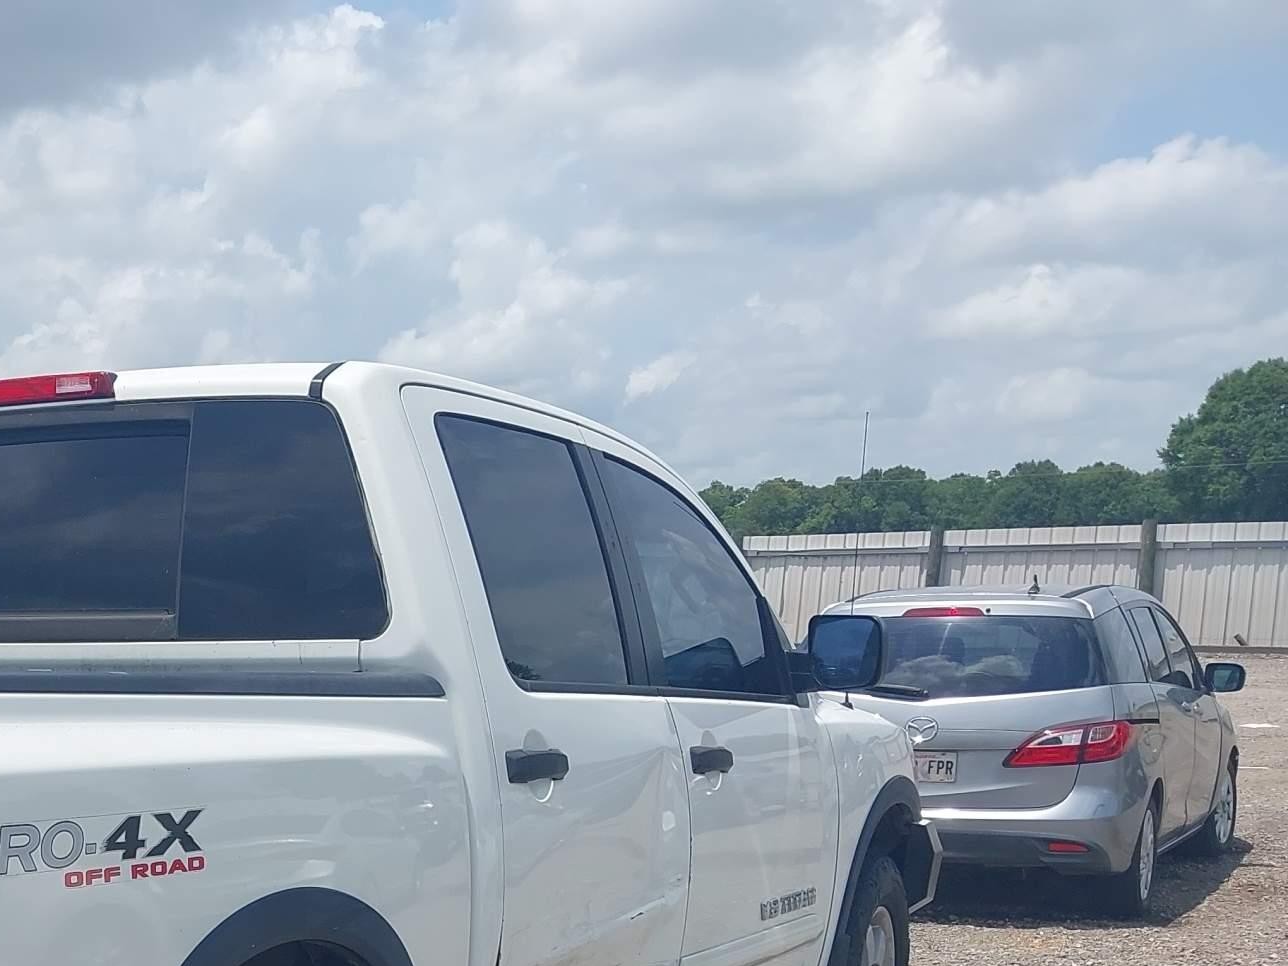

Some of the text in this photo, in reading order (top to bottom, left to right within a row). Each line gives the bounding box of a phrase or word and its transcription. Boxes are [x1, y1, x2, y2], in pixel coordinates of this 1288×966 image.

[927, 760, 954, 775] FPR
[64, 856, 205, 888] OFF ROAD
